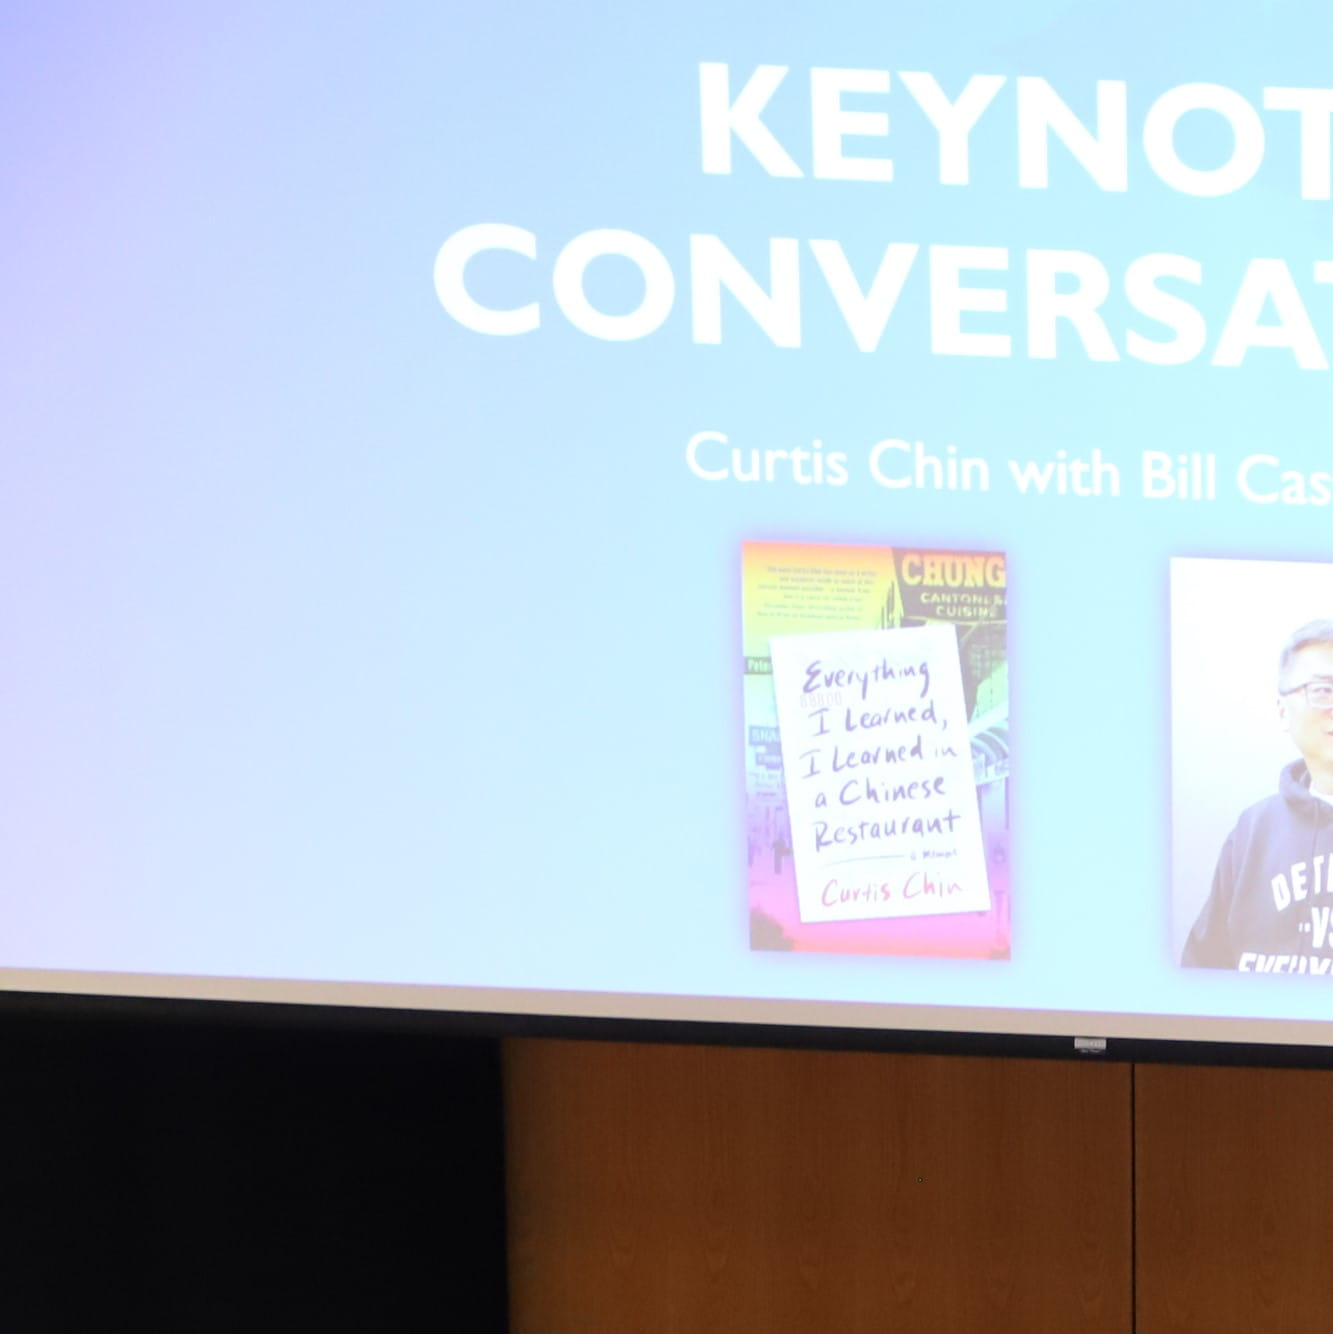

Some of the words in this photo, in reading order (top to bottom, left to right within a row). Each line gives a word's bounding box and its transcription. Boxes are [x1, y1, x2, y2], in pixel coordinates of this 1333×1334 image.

[685, 430, 849, 487] Curtis
[868, 438, 990, 492] Chin
[1007, 448, 1122, 498] with
[1141, 450, 1217, 500] Bill
[901, 551, 1007, 589] CHUNG
[802, 656, 931, 701] Everything
[808, 707, 831, 737] I
[845, 699, 948, 732] Learned,
[799, 748, 822, 779] I
[832, 733, 923, 773] Learned
[934, 745, 958, 758] in
[814, 791, 828, 808] a
[838, 776, 947, 806] Chinese
[812, 808, 962, 853] Restaurant
[821, 878, 892, 908] Curtis
[902, 871, 963, 900] Chin
